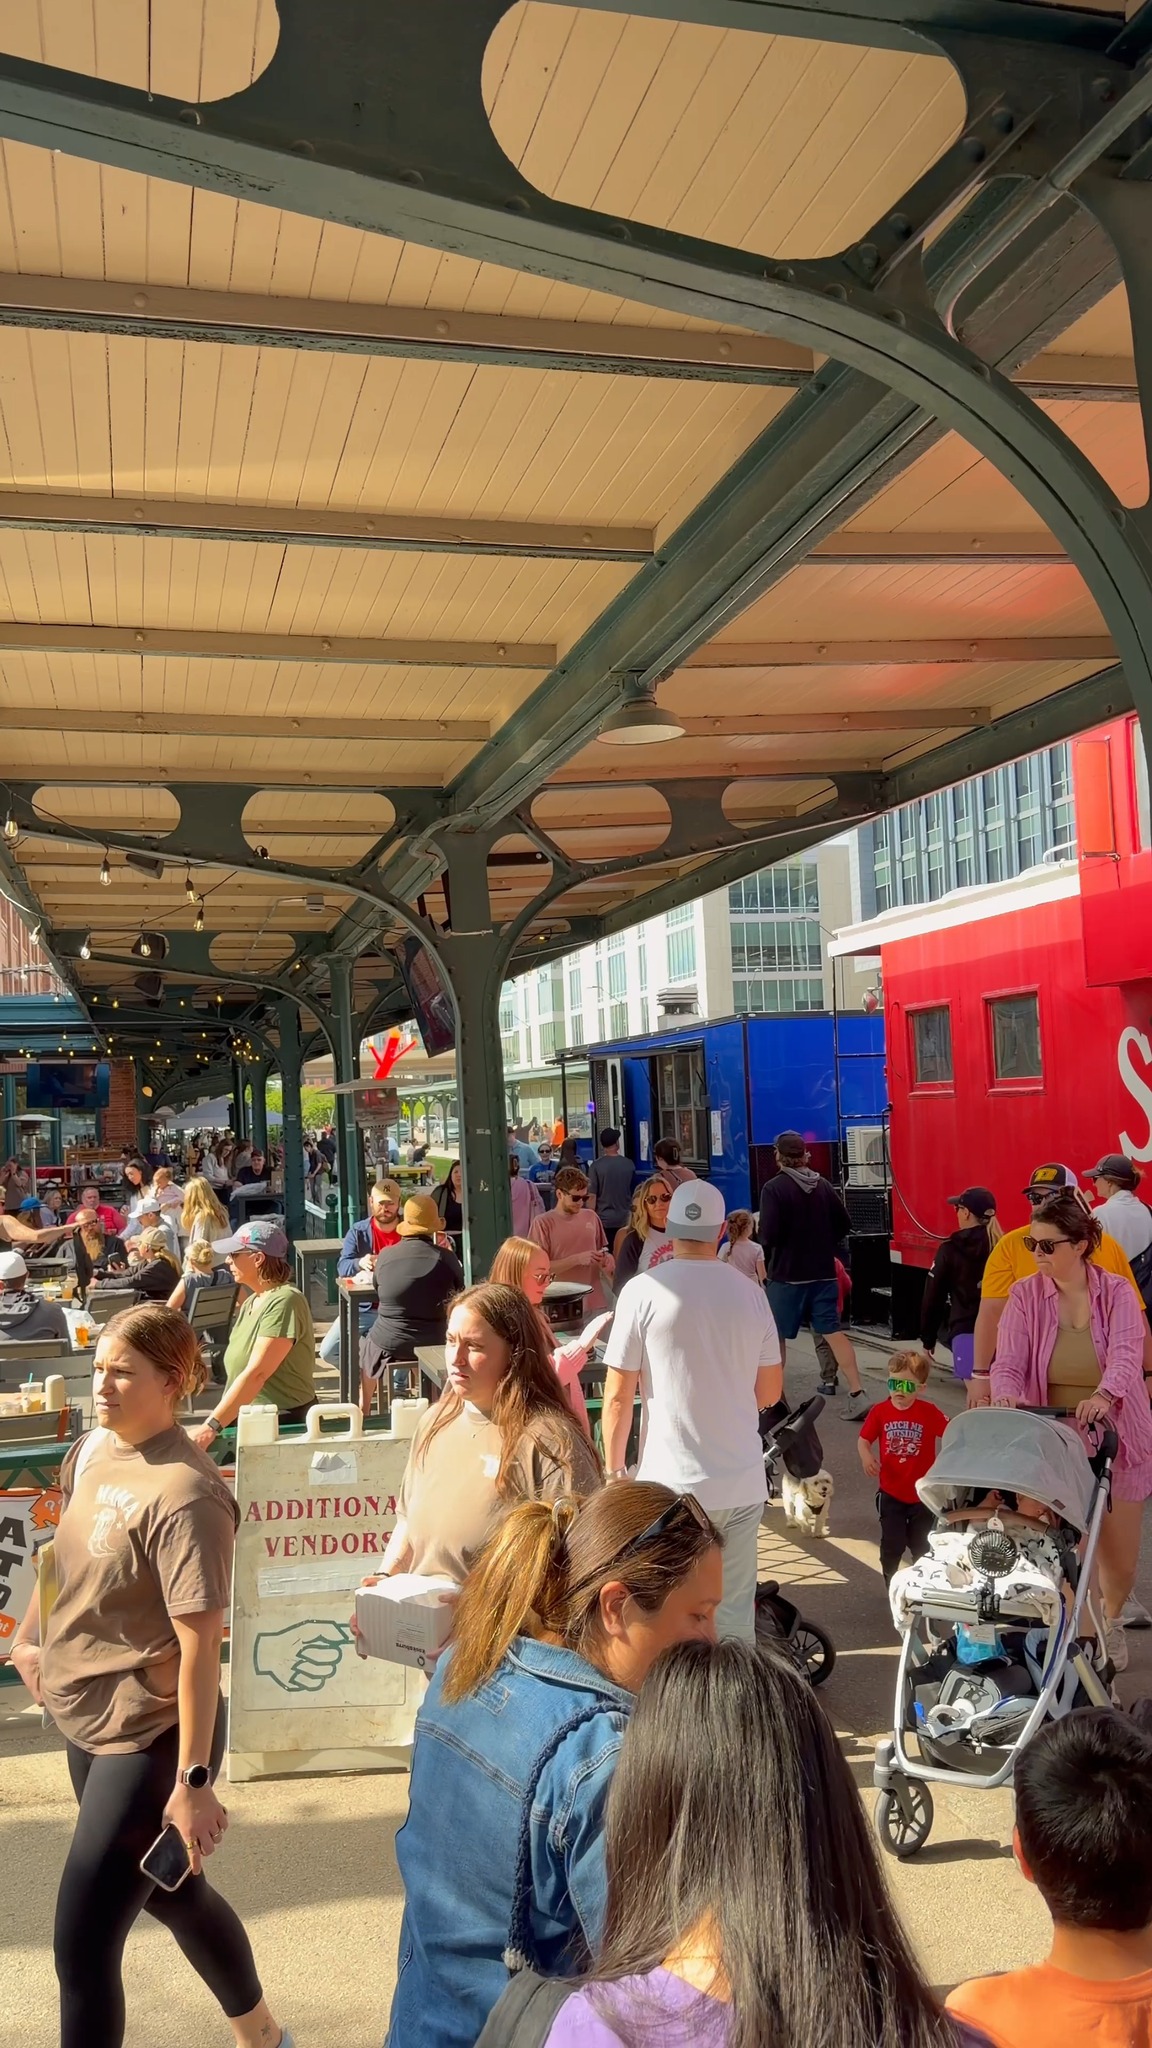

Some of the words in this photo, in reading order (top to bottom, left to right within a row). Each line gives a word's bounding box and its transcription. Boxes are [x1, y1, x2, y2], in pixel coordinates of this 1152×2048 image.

[884, 1421, 909, 1432] CATCH
[911, 1422, 923, 1433] ME
[244, 1495, 397, 1522] ADDITIONA
